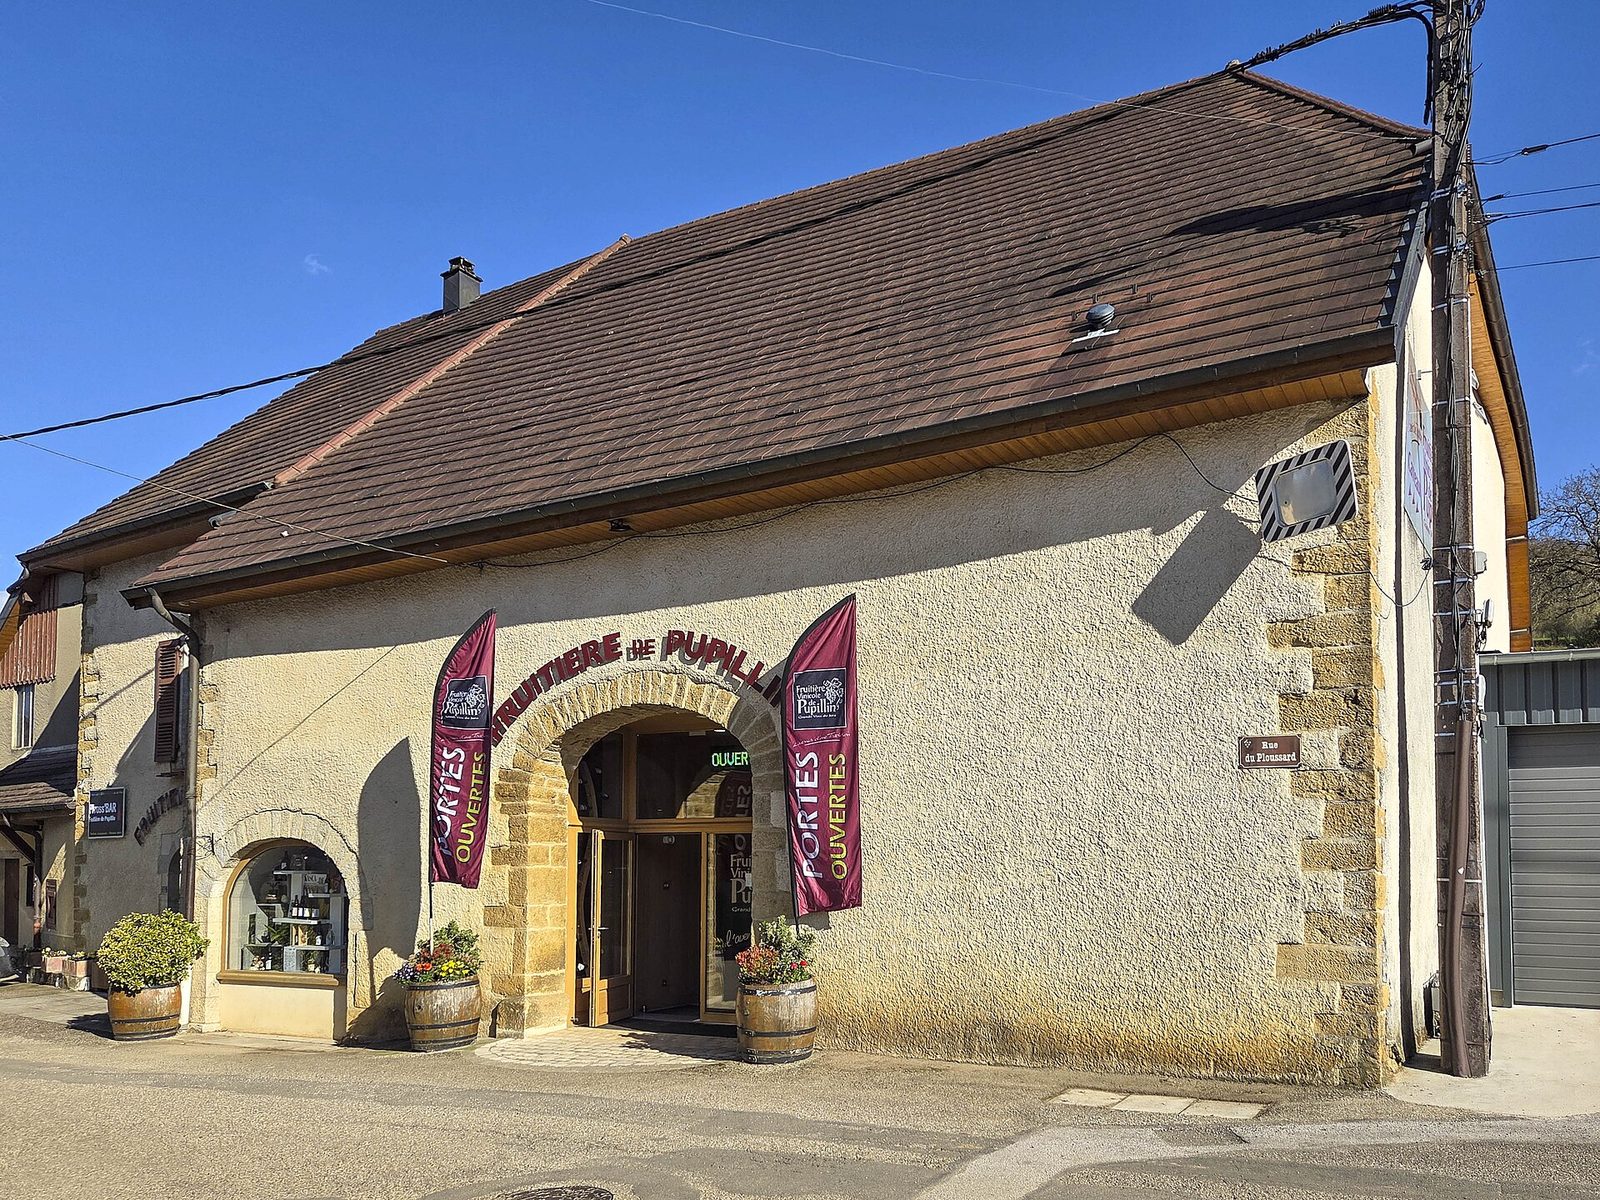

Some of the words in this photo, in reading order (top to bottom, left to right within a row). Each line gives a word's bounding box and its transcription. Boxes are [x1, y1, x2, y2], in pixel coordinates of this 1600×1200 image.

[632, 638, 656, 656] DE
[796, 684, 826, 693] Fruitière
[797, 699, 836, 716] Pupillin
[1261, 741, 1279, 749] Rue
[1245, 754, 1255, 762] du
[1256, 752, 1297, 762] Ploussard
[456, 752, 486, 864] OUVERTES
[795, 751, 823, 878] PORTES
[829, 753, 849, 880] OUVERTES
